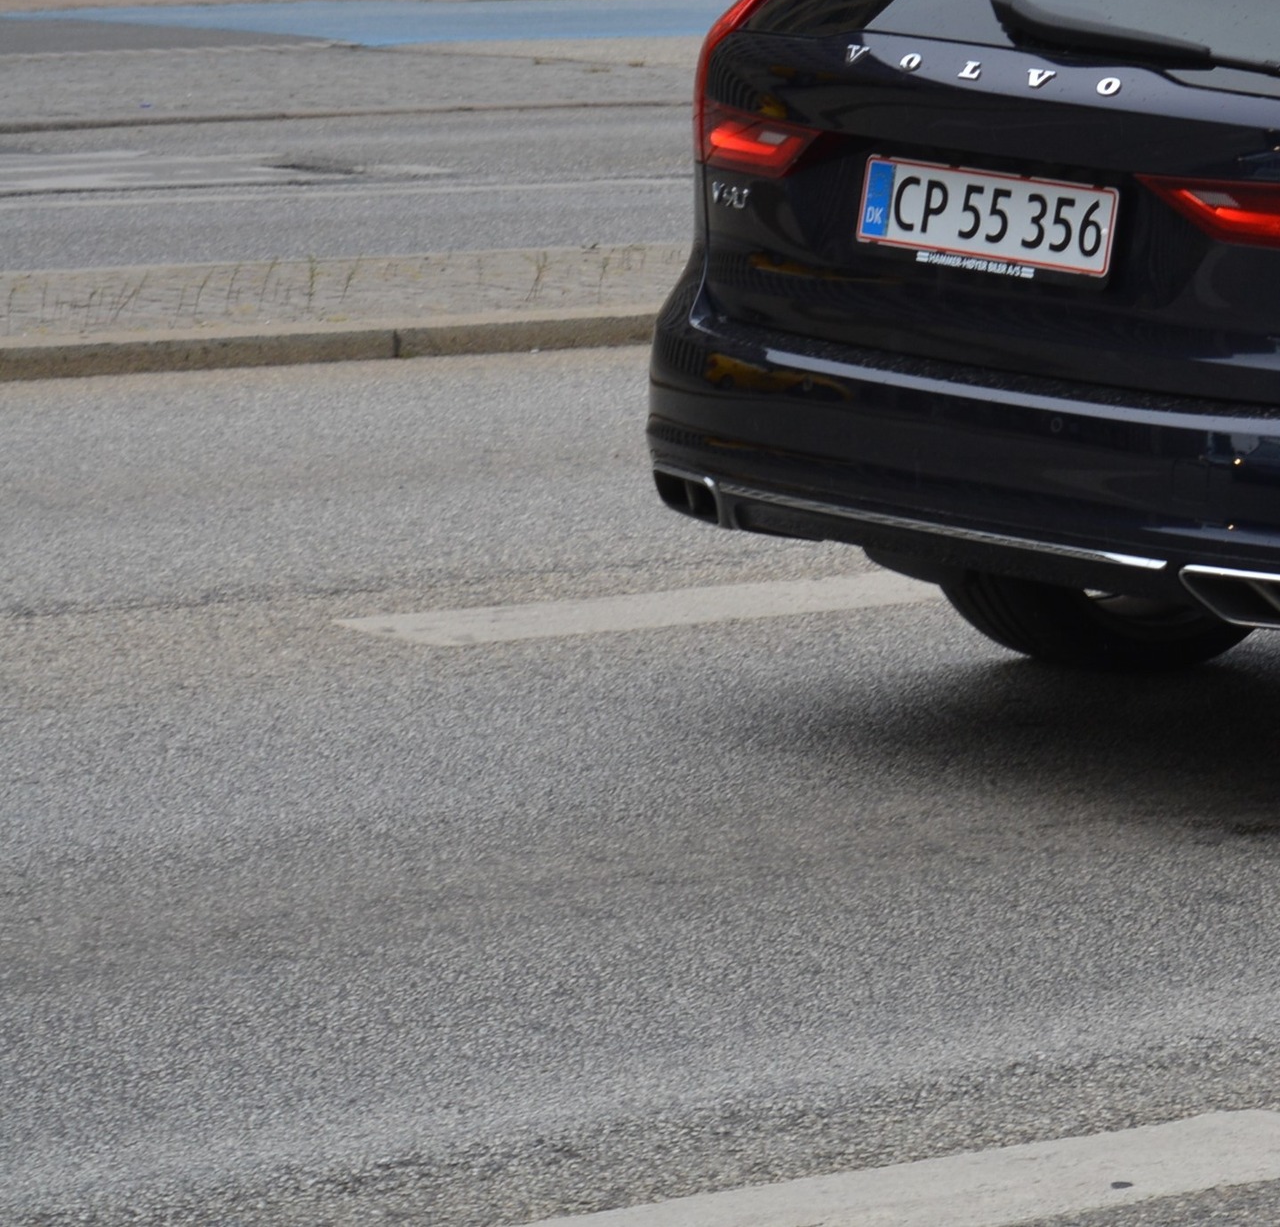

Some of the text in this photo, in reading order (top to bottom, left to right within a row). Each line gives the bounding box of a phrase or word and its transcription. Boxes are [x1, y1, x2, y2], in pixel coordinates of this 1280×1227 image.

[846, 43, 1122, 96] VOLVO
[866, 206, 883, 225] DK
[894, 176, 1102, 258] CP 55 356
